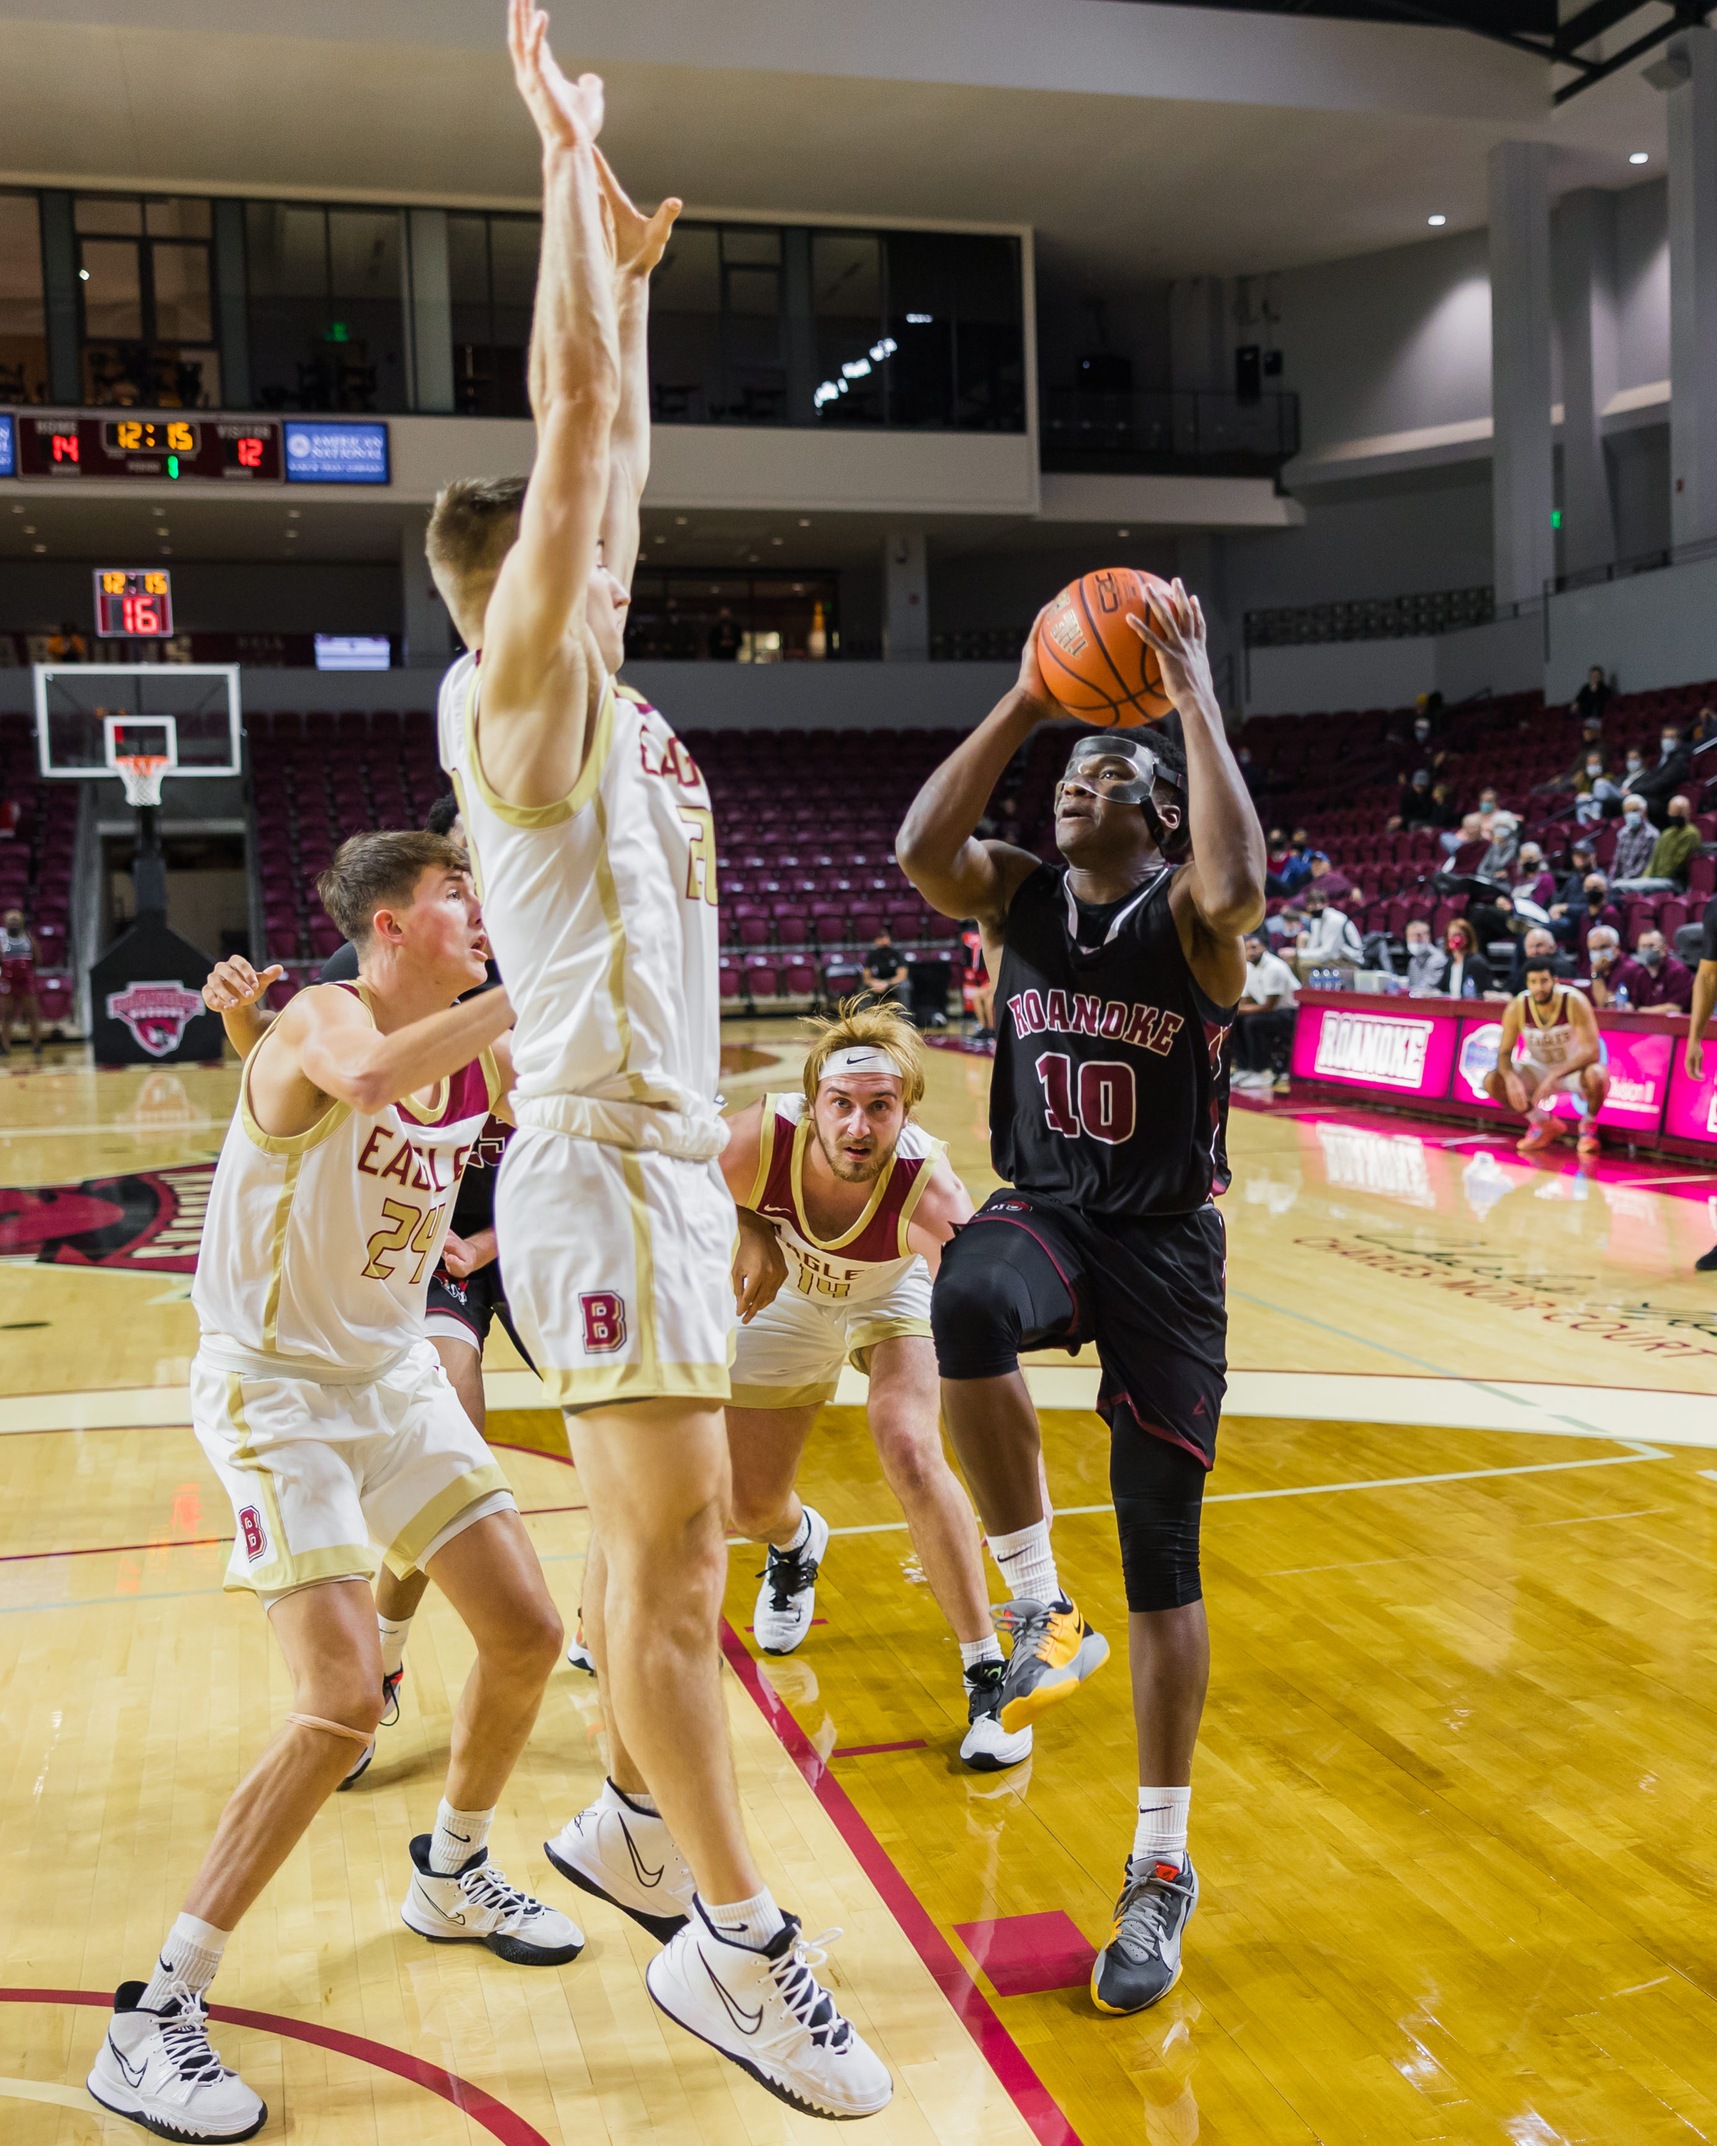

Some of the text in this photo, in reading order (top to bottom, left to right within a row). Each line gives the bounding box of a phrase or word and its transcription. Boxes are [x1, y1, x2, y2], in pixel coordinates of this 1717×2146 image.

[52, 434, 79, 463] 14
[117, 421, 193, 450] 12:15
[237, 438, 263, 467] 12
[122, 596, 159, 634] 16
[1006, 989, 1184, 1056] ROANOKE
[1315, 1011, 1433, 1087] ROANOKE
[1035, 1051, 1136, 1145] 10
[361, 1197, 447, 1285] 24
[578, 1290, 627, 1355] B
